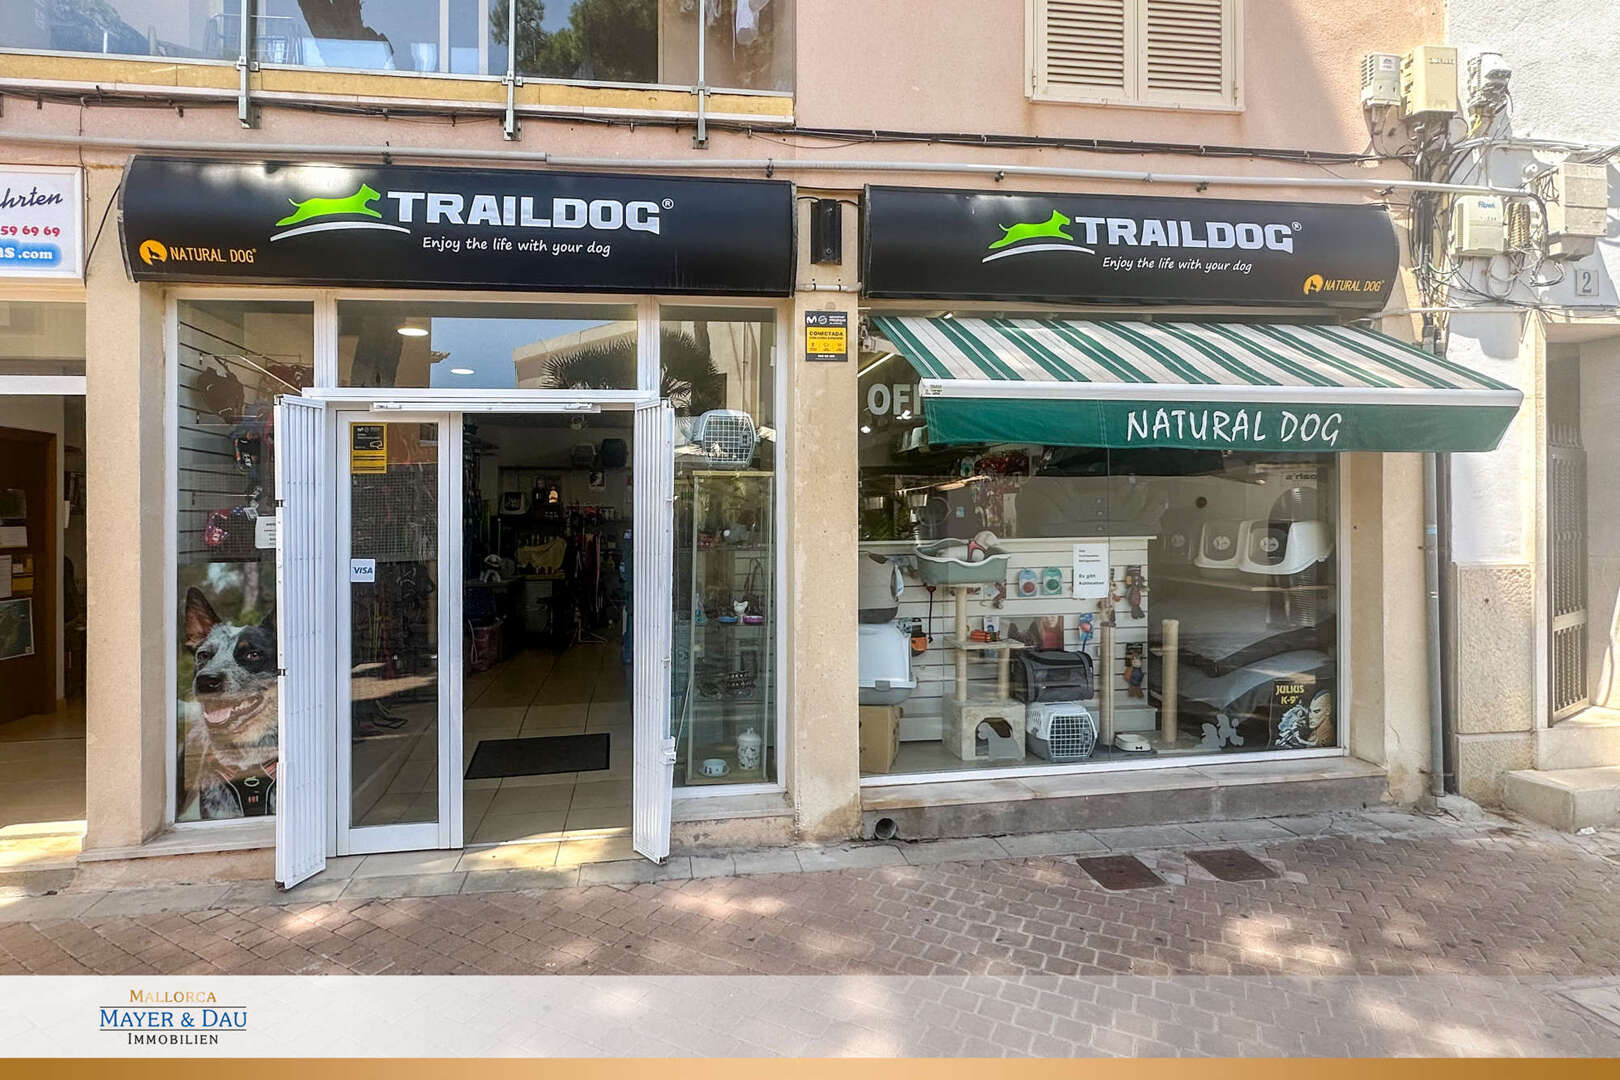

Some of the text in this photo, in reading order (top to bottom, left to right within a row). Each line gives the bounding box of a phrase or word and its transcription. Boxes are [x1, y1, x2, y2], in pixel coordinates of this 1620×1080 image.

[22, 225, 39, 236] 69
[43, 226, 61, 237] 69
[423, 236, 611, 257] Enjoy the life with your dog
[169, 247, 227, 262] NATURAL
[1102, 256, 1253, 274] Enjoy the life with your dog
[1323, 279, 1361, 292] NATURAL
[1582, 271, 1592, 293] 2
[1127, 407, 1343, 447] NATURAL DOG
[353, 566, 373, 574] VISA
[1275, 685, 1305, 696] JULIUS
